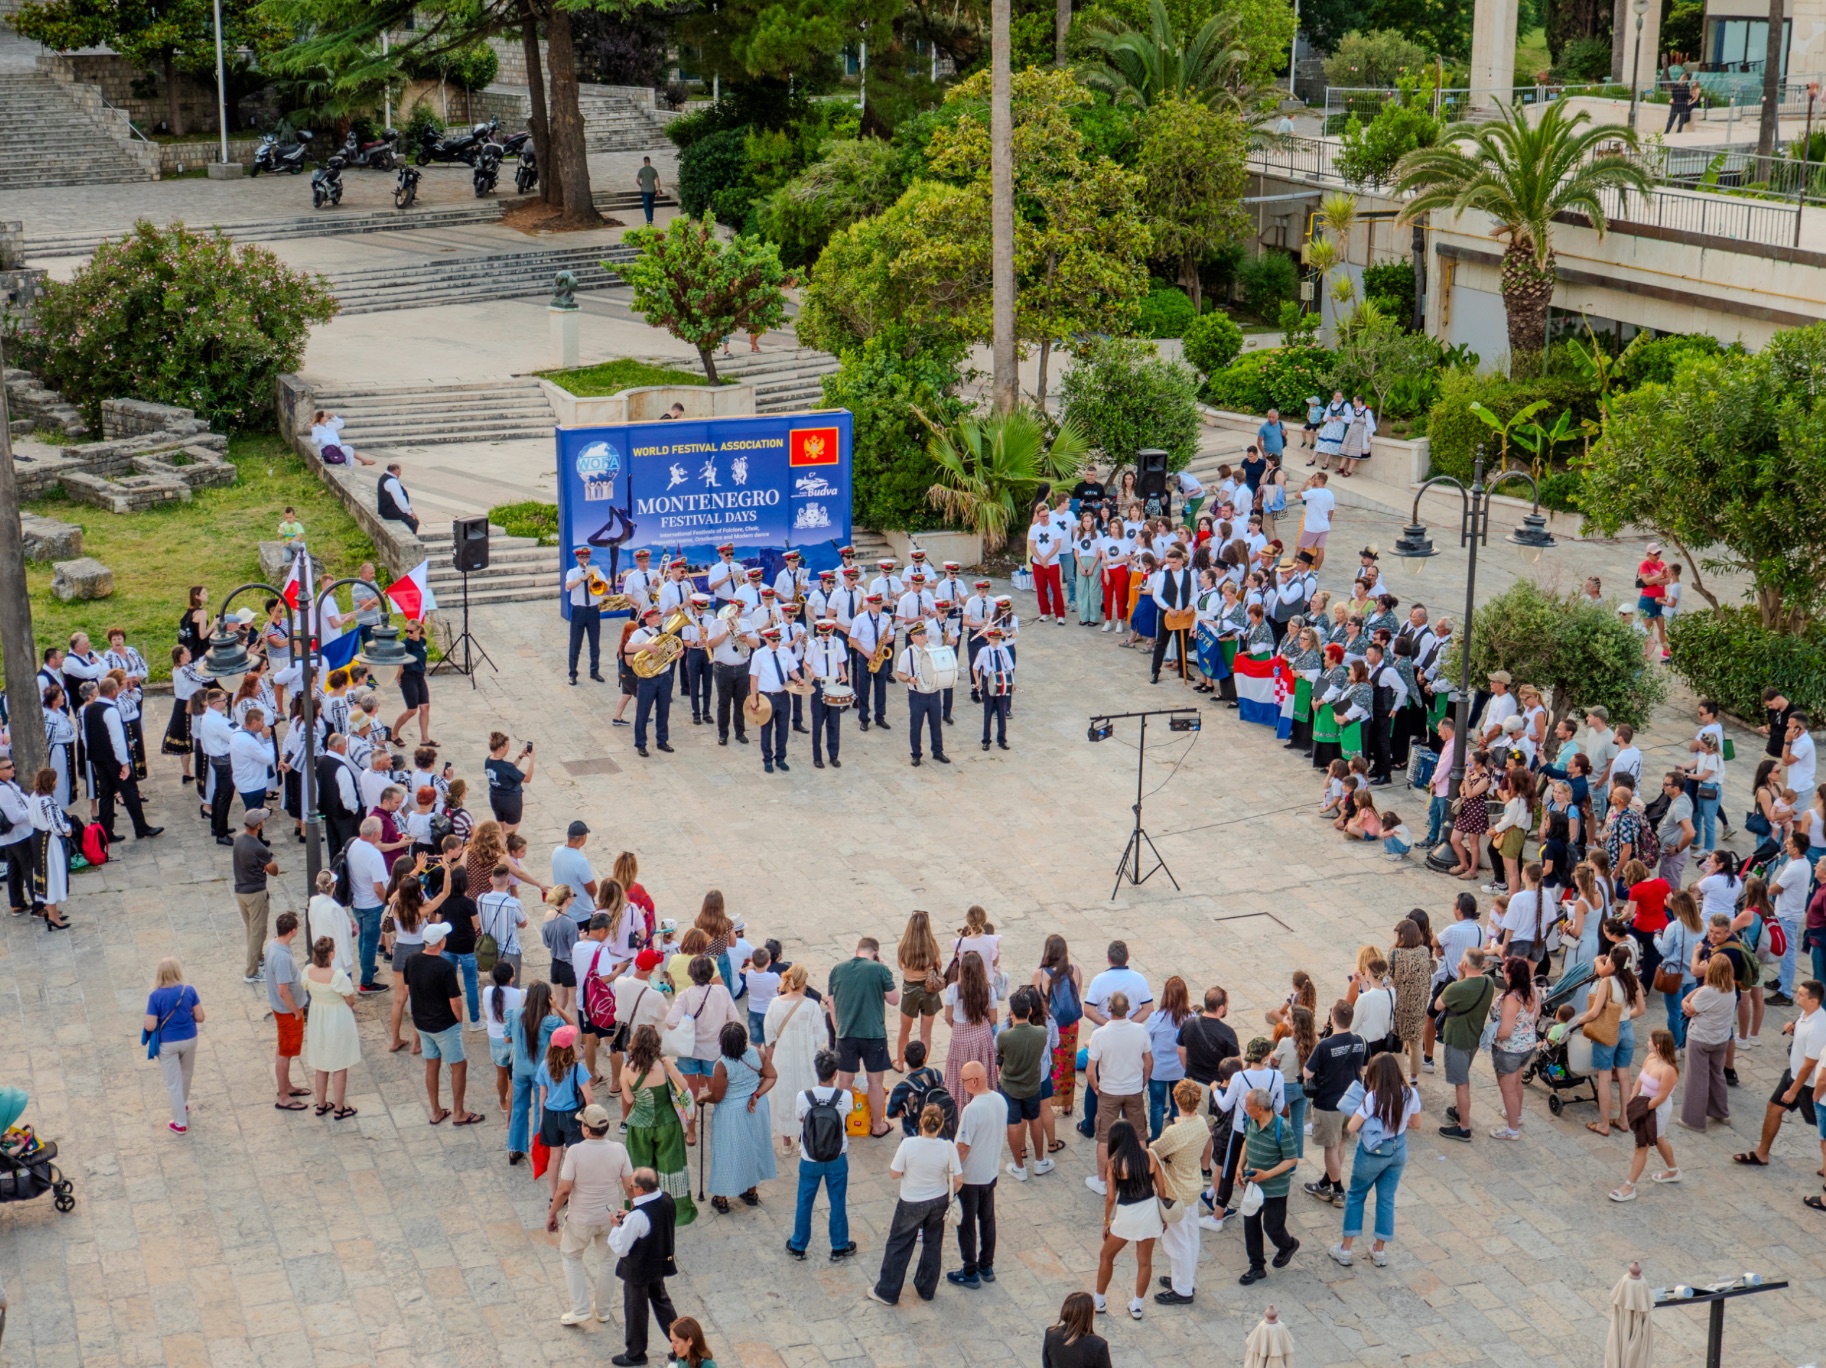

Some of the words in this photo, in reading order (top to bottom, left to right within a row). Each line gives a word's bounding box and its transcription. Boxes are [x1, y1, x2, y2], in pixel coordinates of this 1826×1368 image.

[633, 446, 669, 457] WORLD
[672, 443, 718, 454] FESTIVAL
[720, 439, 784, 451] ASSOCIATION
[807, 486, 838, 497] Budva
[637, 489, 780, 515] MONTENEGRO
[661, 512, 722, 528] FESTIVAL
[725, 510, 757, 523] DAYS
[660, 530, 692, 538] International
[693, 528, 715, 536] Festivals
